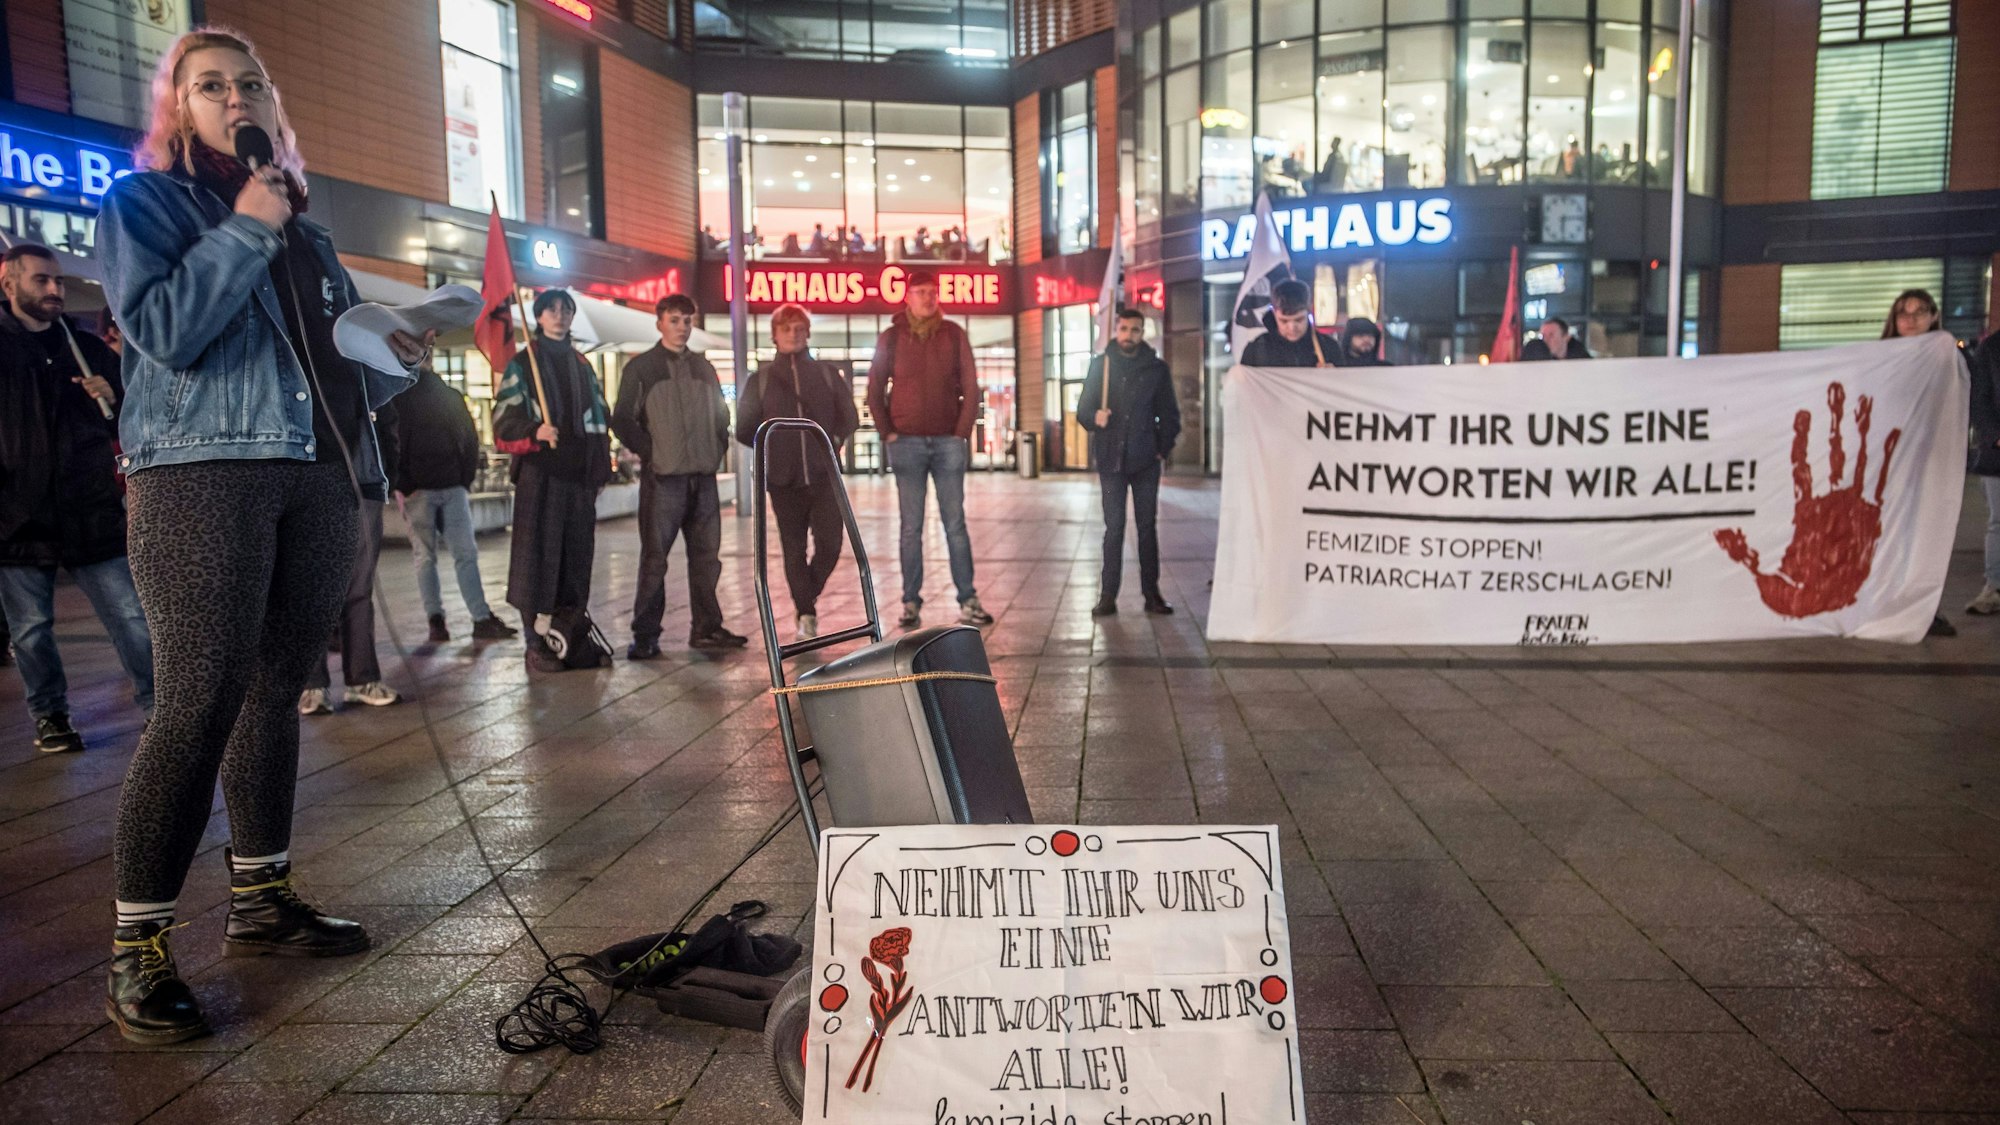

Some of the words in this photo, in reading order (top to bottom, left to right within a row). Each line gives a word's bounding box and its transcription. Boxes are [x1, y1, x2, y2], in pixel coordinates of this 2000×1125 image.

[0, 132, 64, 188] he
[79, 149, 132, 196] B
[724, 264, 999, 304] ATHAUS-GERIE
[1306, 410, 1437, 442] NEHMT
[1450, 414, 1514, 446] IHR
[1528, 412, 1610, 447] UNS
[1624, 408, 1709, 443] EINE
[1307, 461, 1552, 499] ANTWORTEN
[1566, 465, 1638, 498] WIR
[1651, 459, 1757, 496] ALLE!
[1306, 530, 1411, 556] FEMIZIDE
[1420, 537, 1543, 561] STOPPEN!
[1305, 562, 1472, 591] PATRIARCHAT
[1479, 567, 1673, 592] ZERSCHLAGEN!
[1524, 613, 1589, 631] FRAUEN
[870, 865, 1046, 919] NEHMT
[1061, 868, 1146, 918] IHR
[1154, 868, 1246, 912] UNS
[999, 924, 1112, 970] EINE
[898, 988, 1166, 1037] ANTWORTEN
[1171, 979, 1264, 1021] WIR
[990, 1046, 1129, 1094] ALLE!
